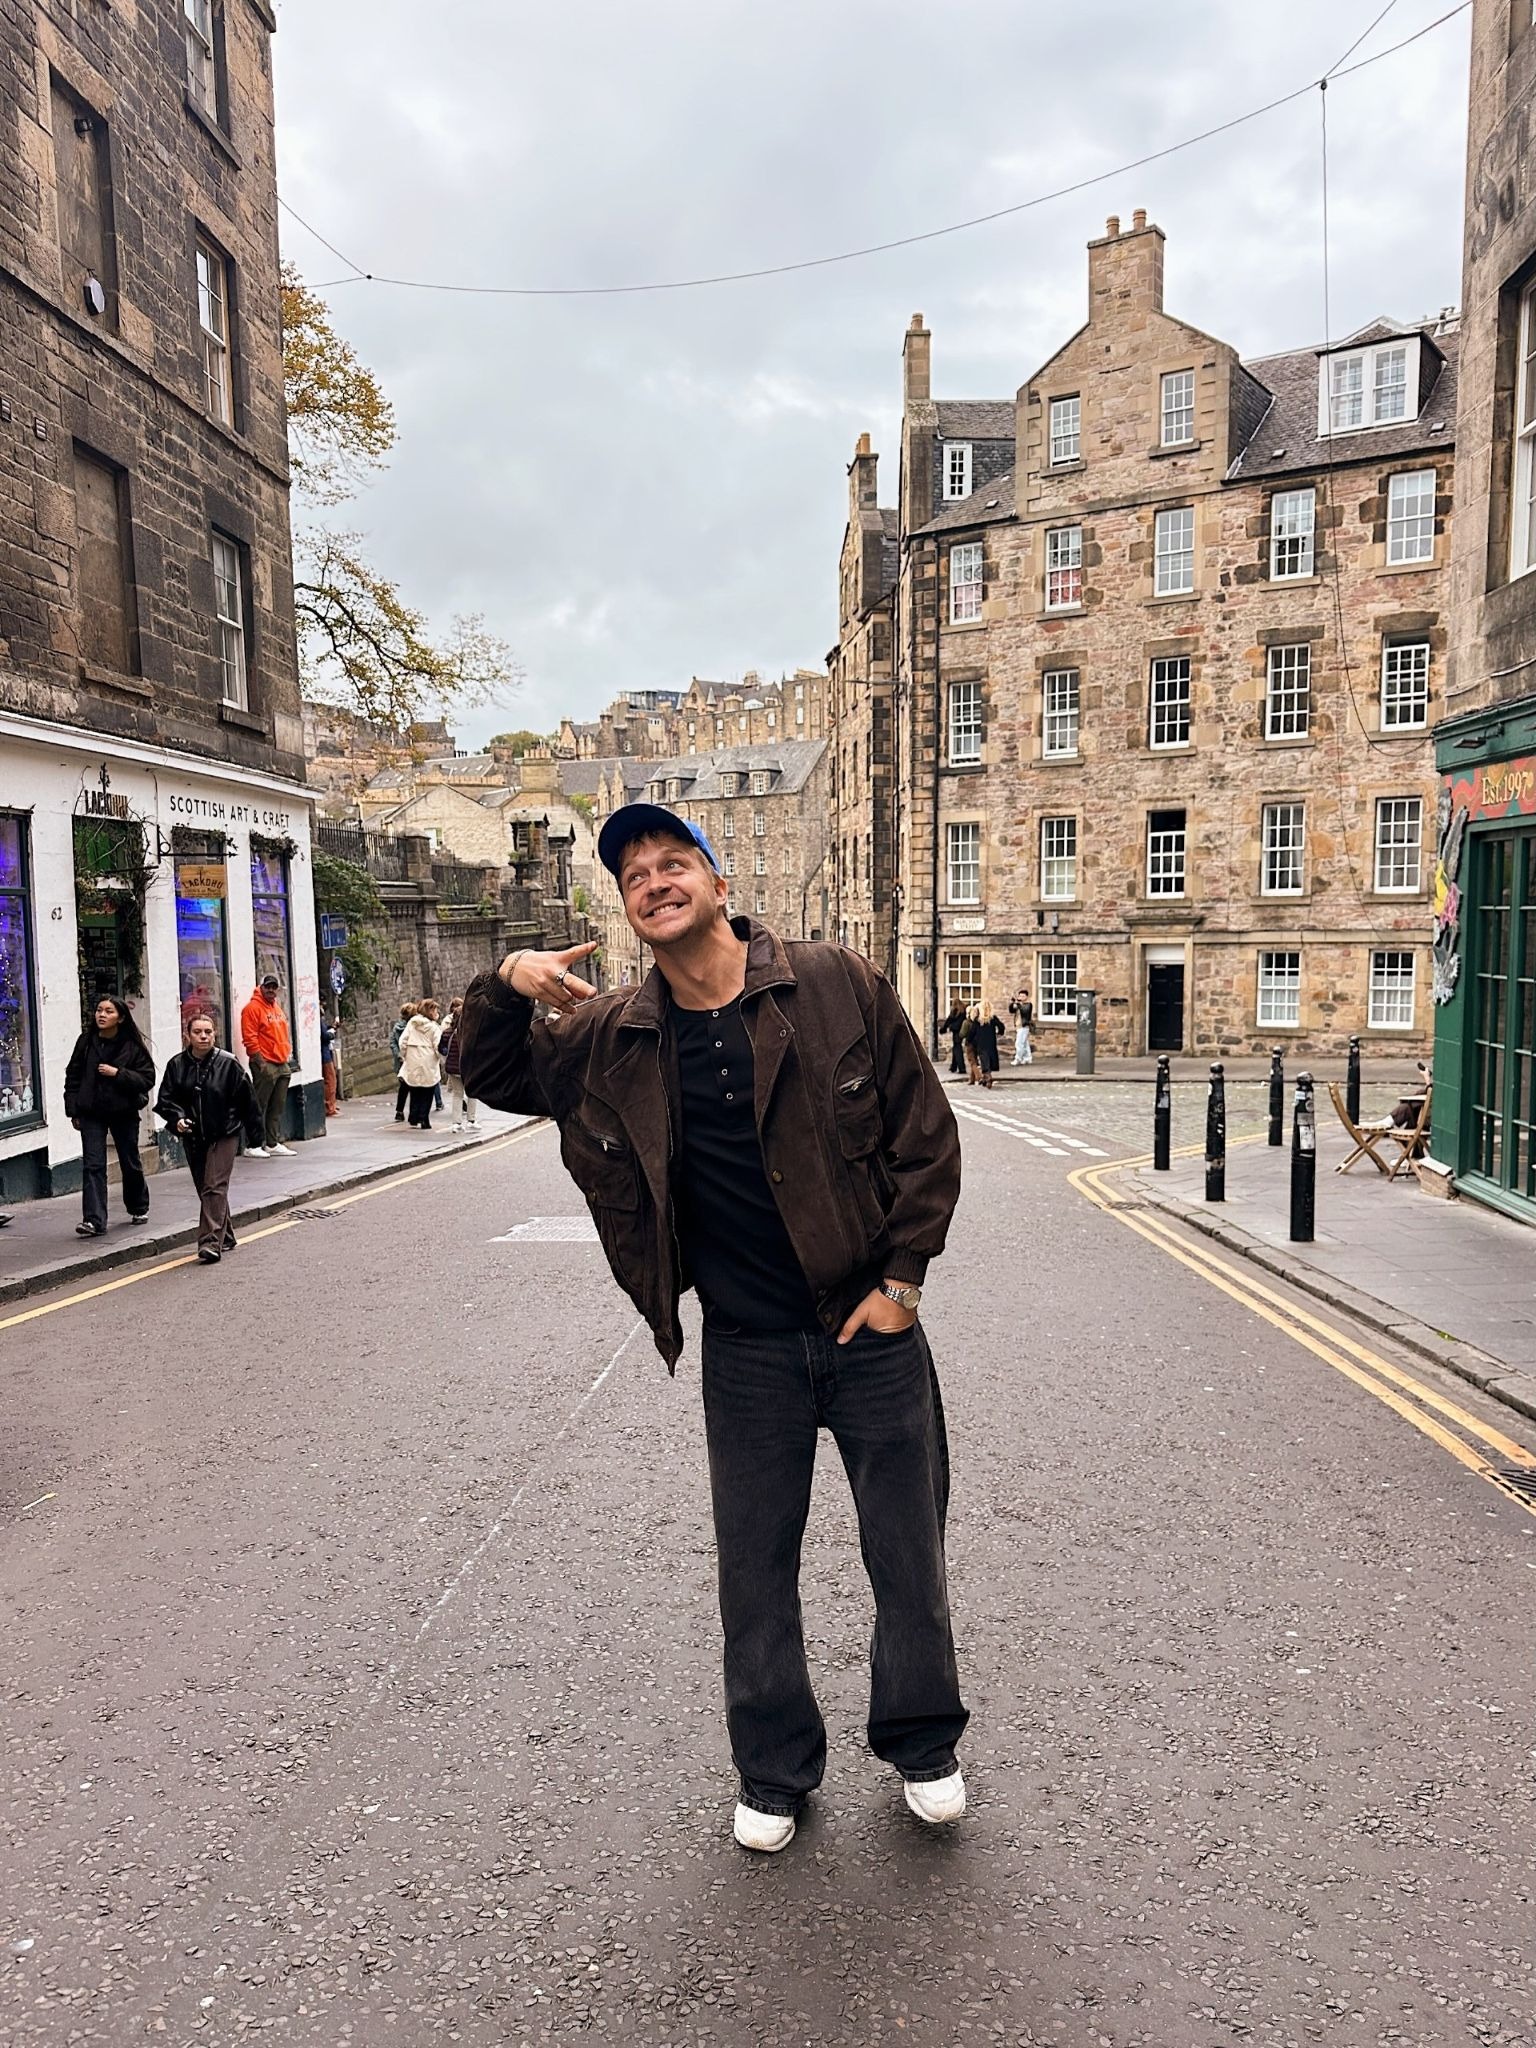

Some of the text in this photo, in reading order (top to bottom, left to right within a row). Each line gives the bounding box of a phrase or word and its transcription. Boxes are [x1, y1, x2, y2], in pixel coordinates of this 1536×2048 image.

[170, 795, 290, 828] SCOTTISH ART & CRAFT
